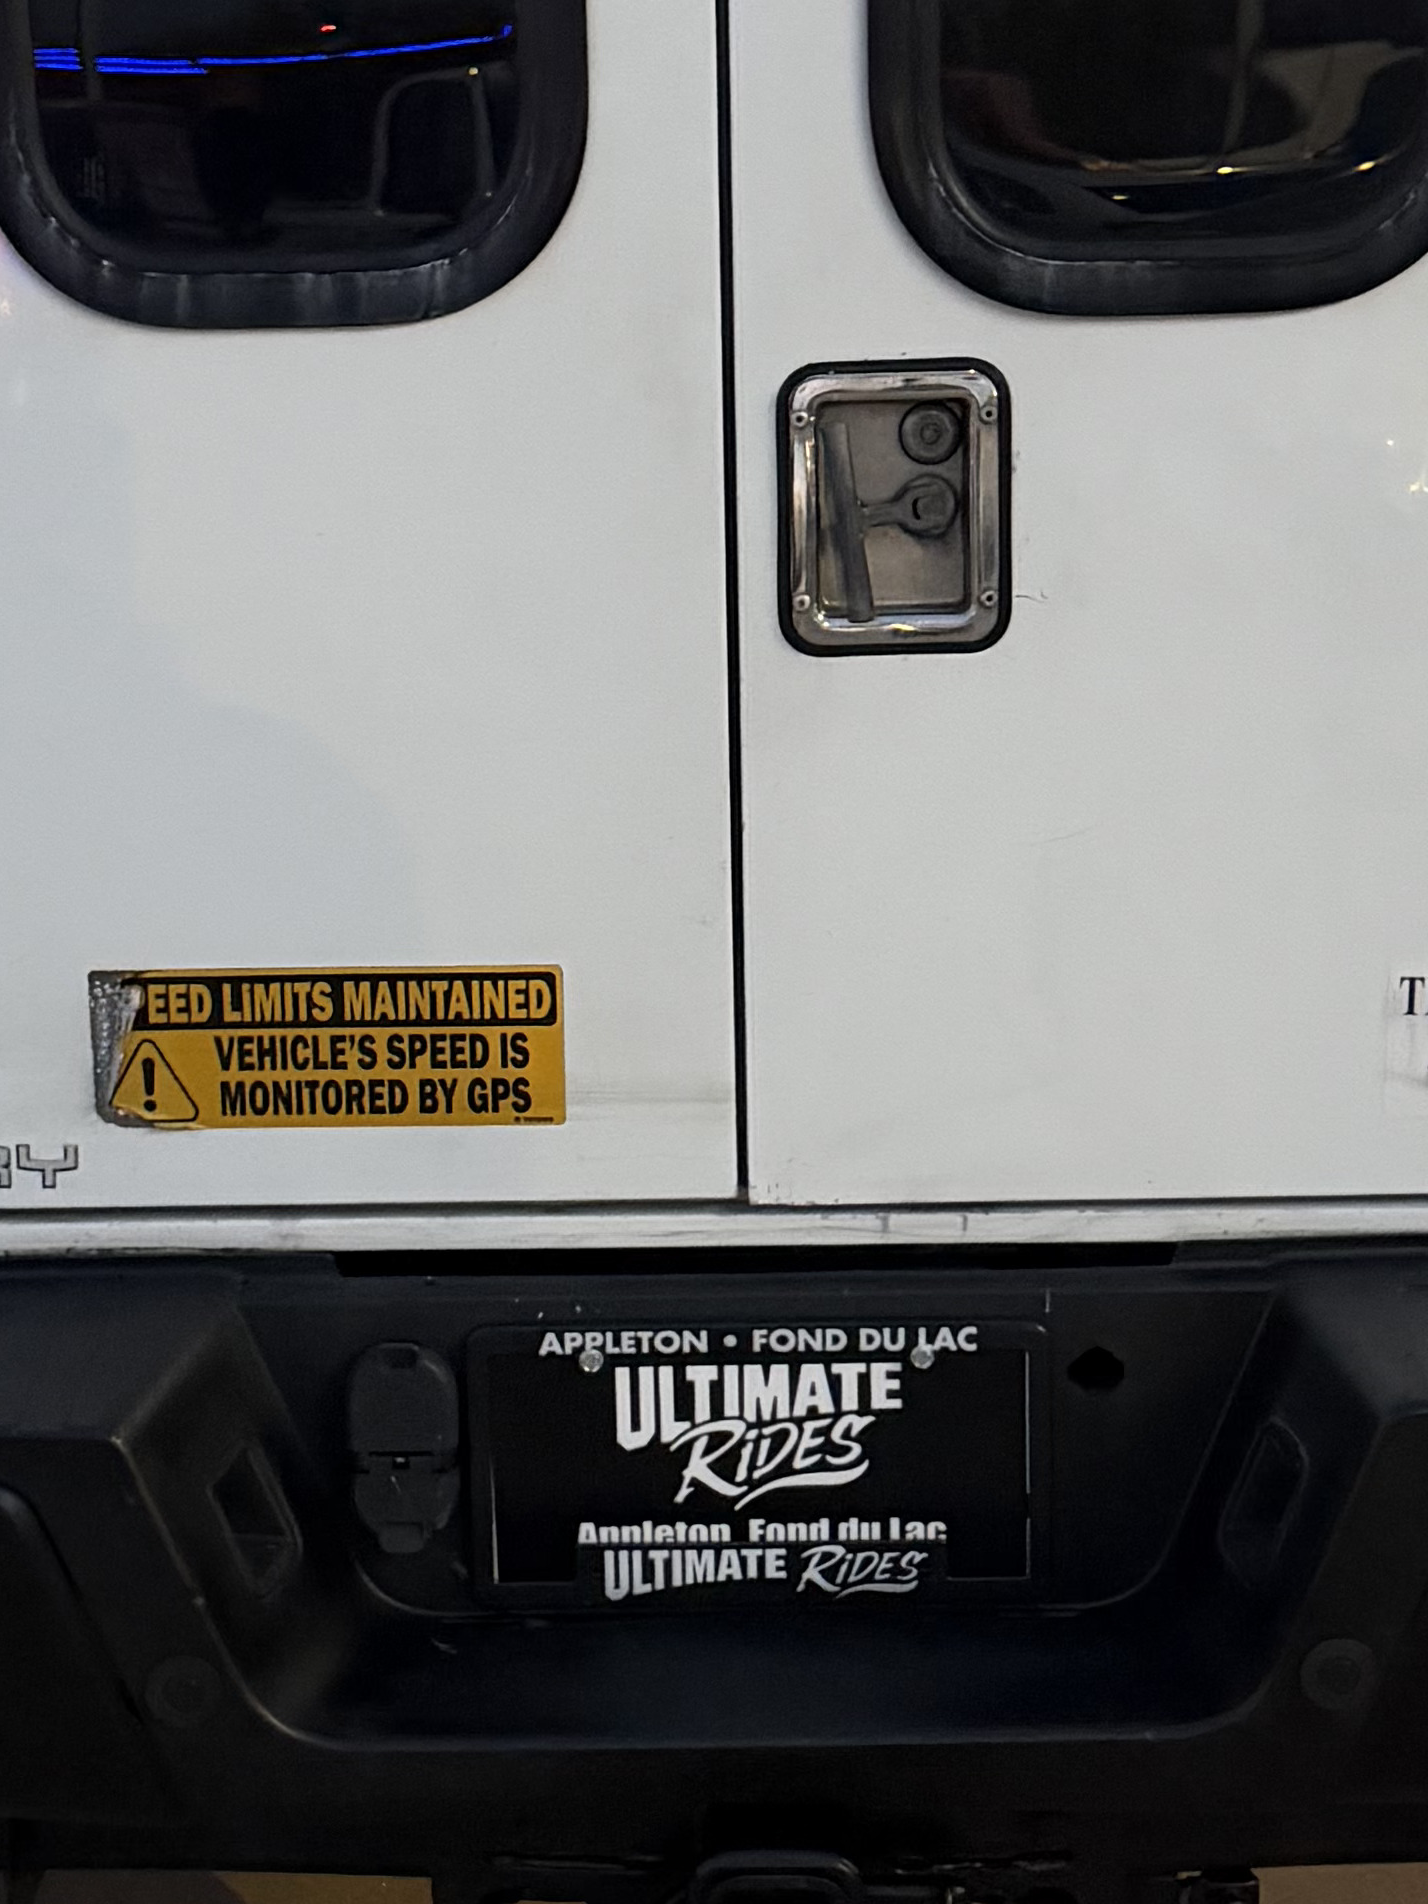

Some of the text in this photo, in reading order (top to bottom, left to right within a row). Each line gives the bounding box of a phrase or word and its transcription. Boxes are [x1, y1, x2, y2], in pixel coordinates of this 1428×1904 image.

[140, 978, 551, 1025] EED LIMITS MAINTAINED
[214, 1032, 530, 1073] VEHICLE'S SPEED IS
[220, 1077, 533, 1117] MONITORED BY GPS
[538, 1326, 979, 1356] APPLETON FOND DU LAC
[614, 1361, 904, 1452] ULTIMATE
[748, 1517, 830, 1542] Fond
[837, 1517, 881, 1541] du
[603, 1548, 788, 1601] ULTIMATE
